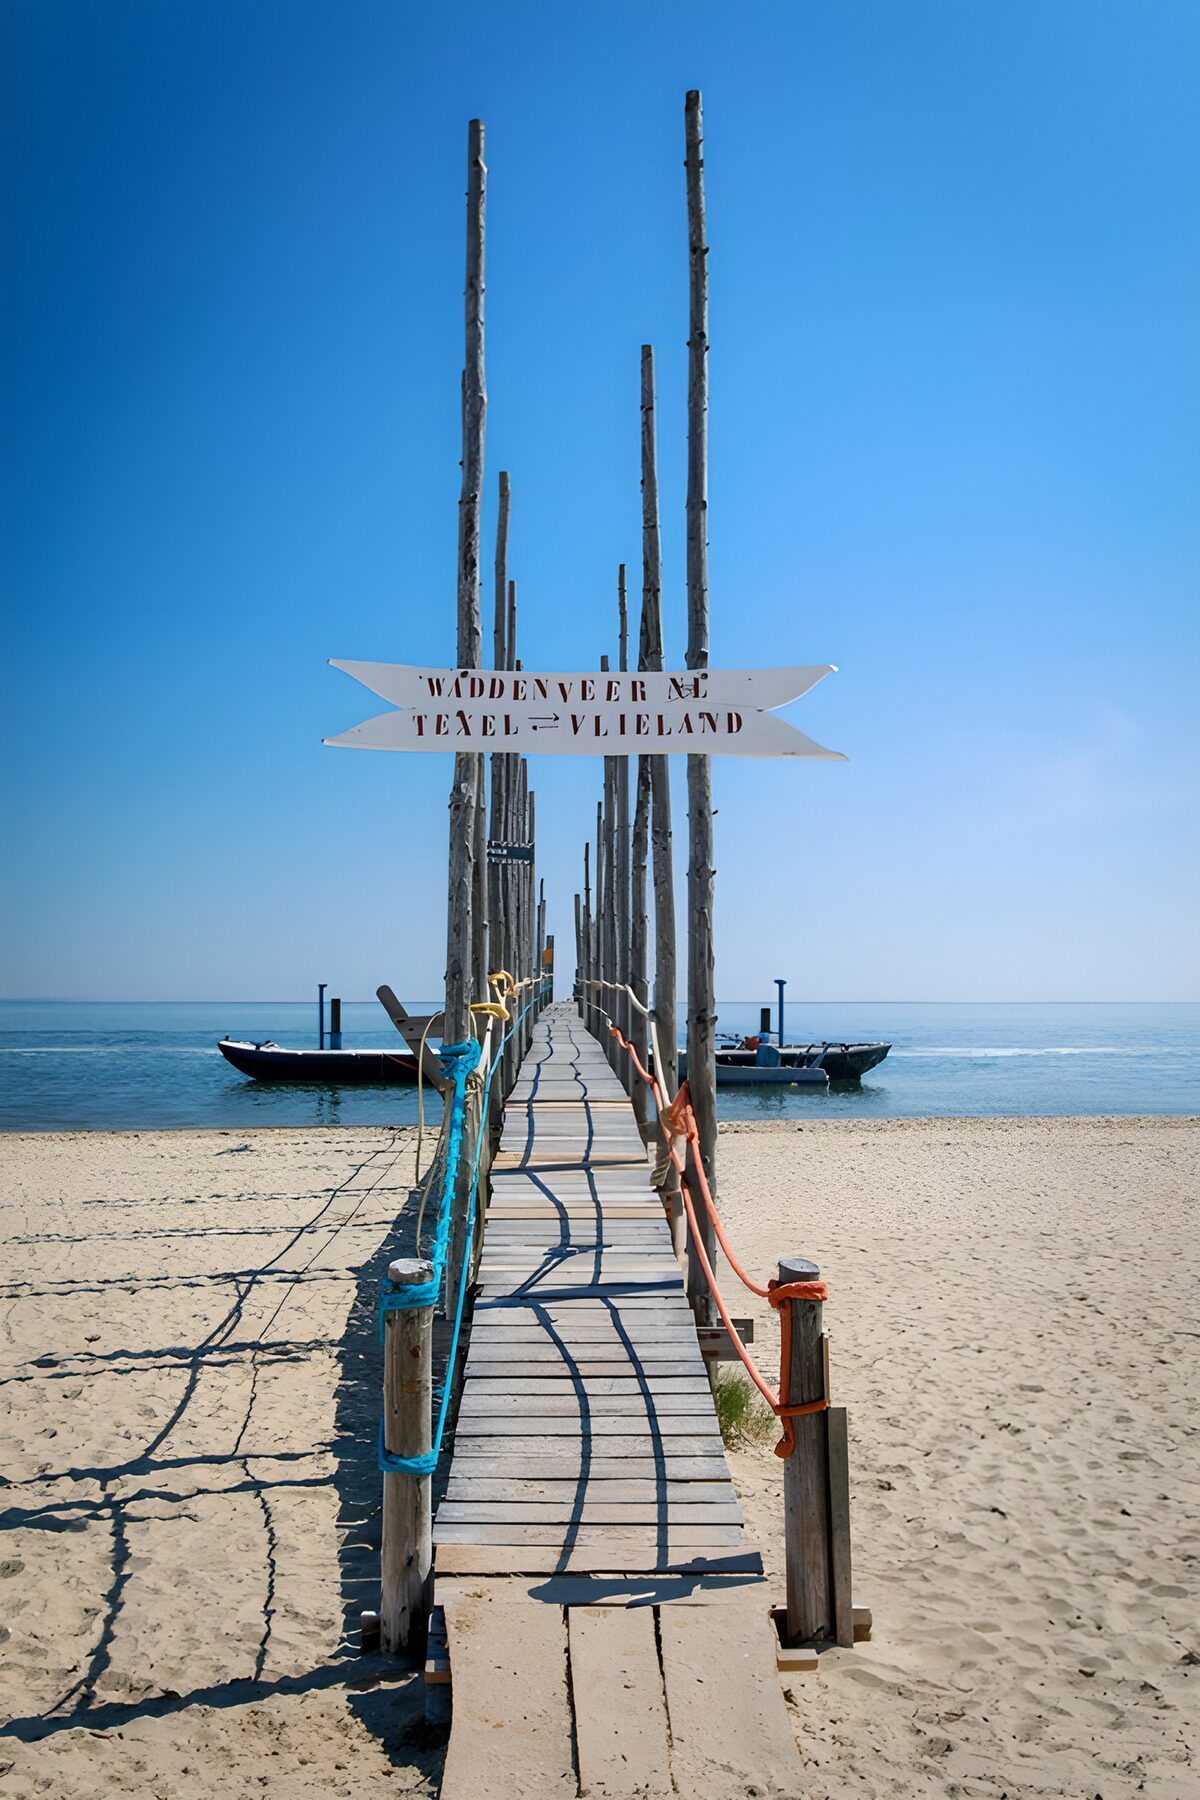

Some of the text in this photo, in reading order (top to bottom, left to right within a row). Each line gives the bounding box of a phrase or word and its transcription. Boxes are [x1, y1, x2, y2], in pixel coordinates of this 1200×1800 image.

[428, 676, 648, 703] WADDENVEER
[411, 711, 744, 737] TEXEL VLIELAND
